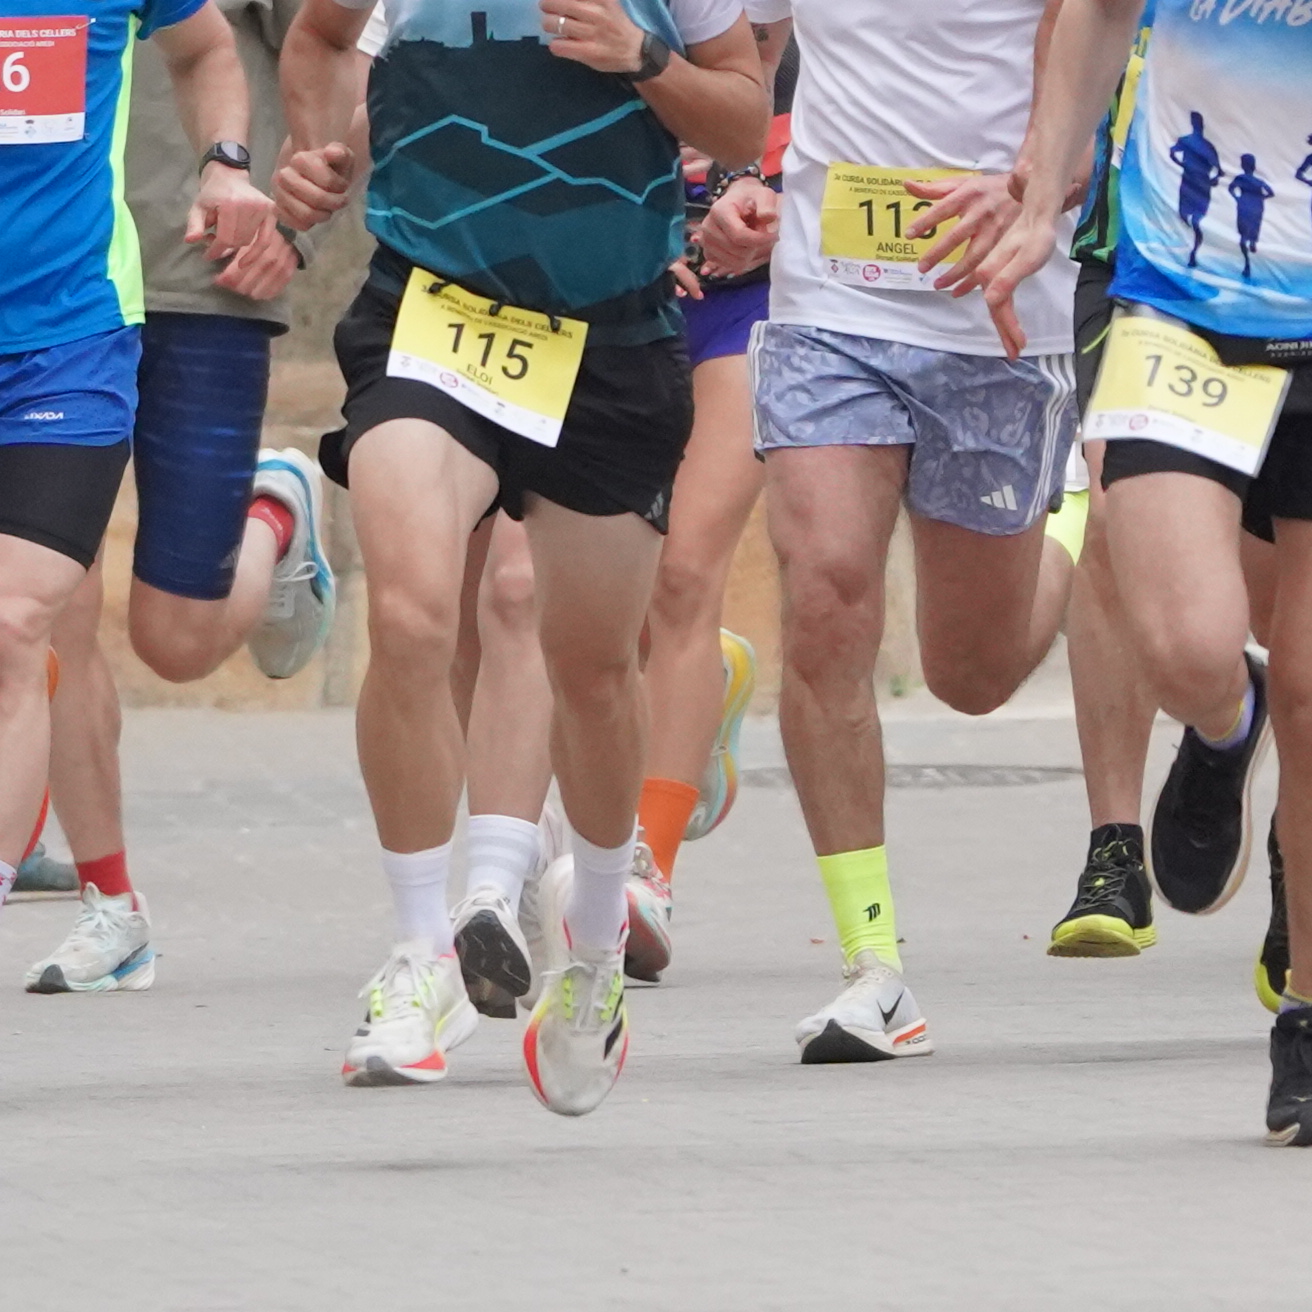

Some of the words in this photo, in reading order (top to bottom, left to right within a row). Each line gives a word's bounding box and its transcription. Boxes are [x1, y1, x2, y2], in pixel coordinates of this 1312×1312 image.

[866, 176, 905, 187] SOLIDÀRI
[876, 242, 919, 255] ANGEL
[447, 322, 534, 380] 115
[1144, 353, 1229, 408] 139
